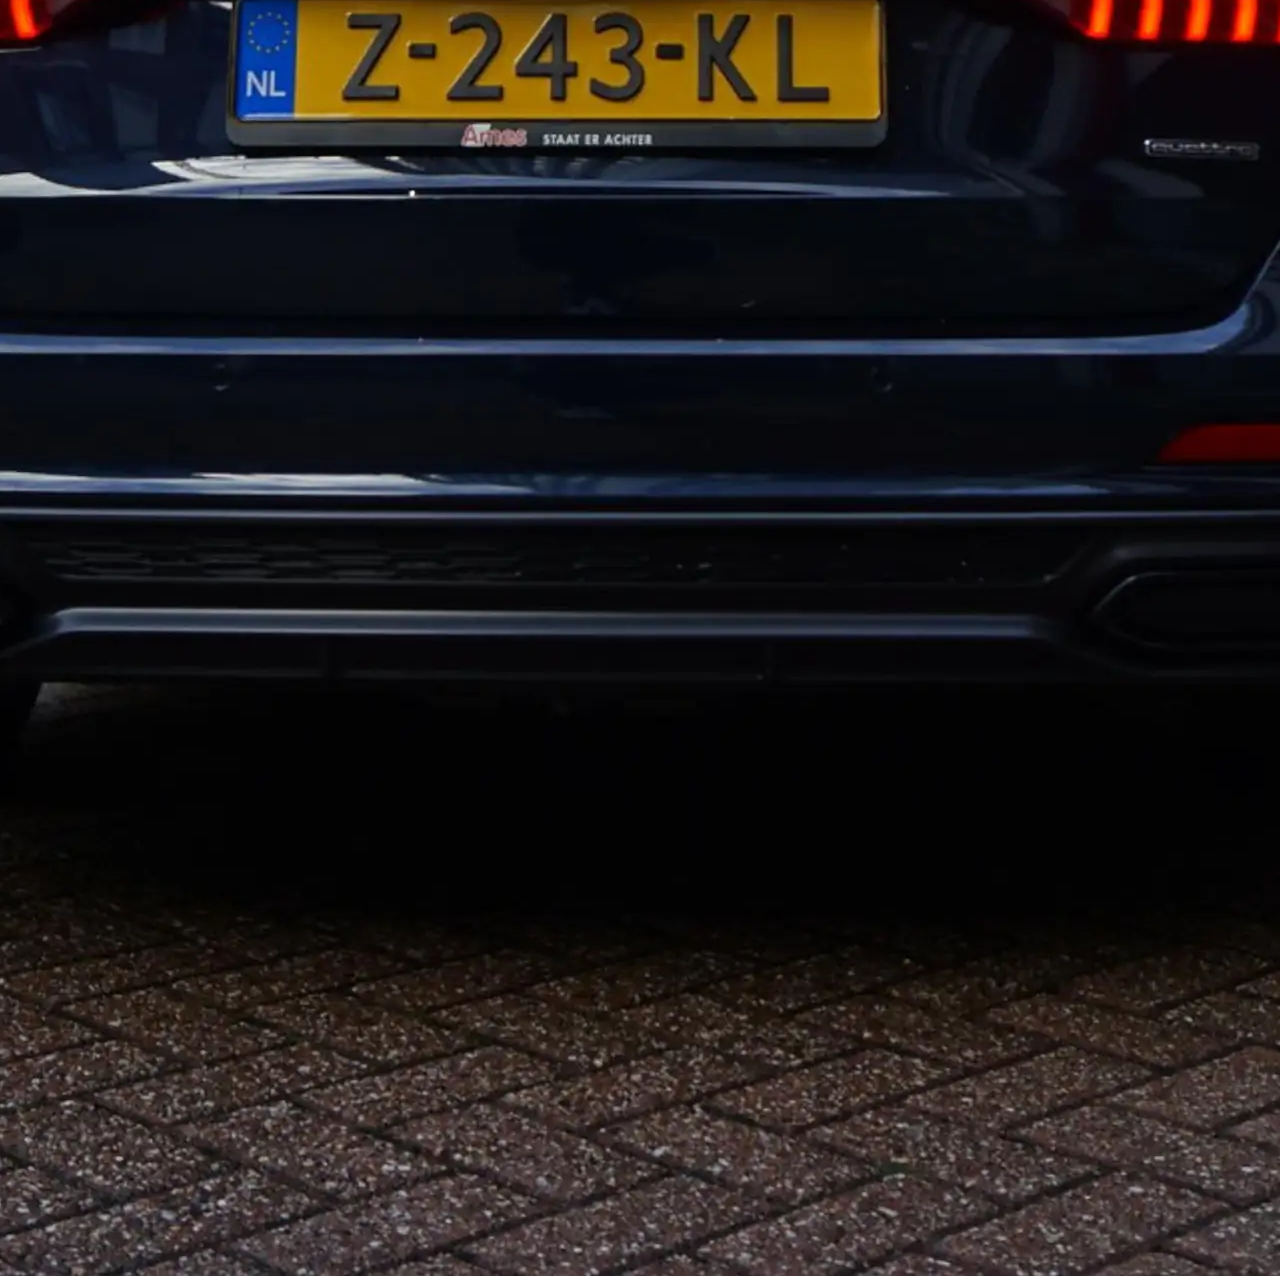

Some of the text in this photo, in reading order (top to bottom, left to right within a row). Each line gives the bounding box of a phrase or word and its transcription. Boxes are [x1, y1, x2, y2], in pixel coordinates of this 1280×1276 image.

[246, 11, 830, 102] NL Z-243-KL
[542, 133, 580, 146] STAAT
[584, 133, 600, 146] ER
[603, 133, 653, 146] ACHTER
